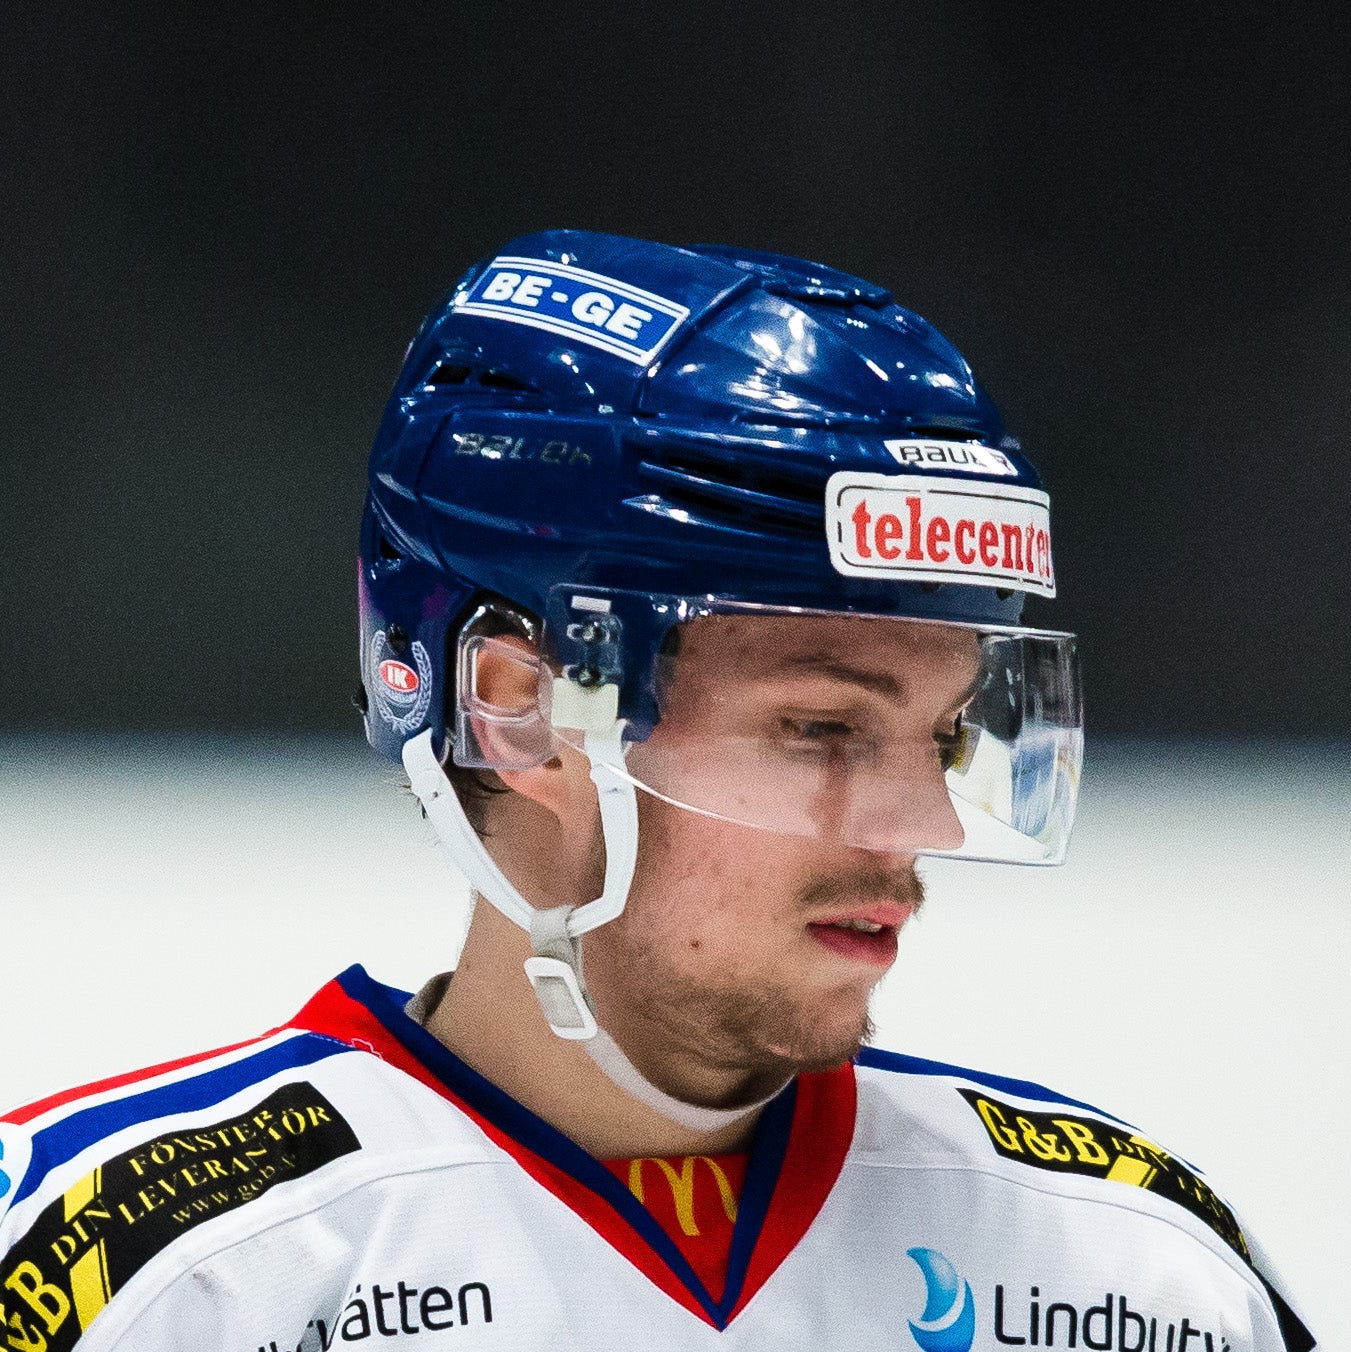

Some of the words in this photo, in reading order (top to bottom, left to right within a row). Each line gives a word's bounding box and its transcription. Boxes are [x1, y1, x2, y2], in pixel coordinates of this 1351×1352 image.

[387, 664, 408, 688] IK
[974, 1097, 1110, 1167] G&B
[51, 1198, 111, 1265] DIN
